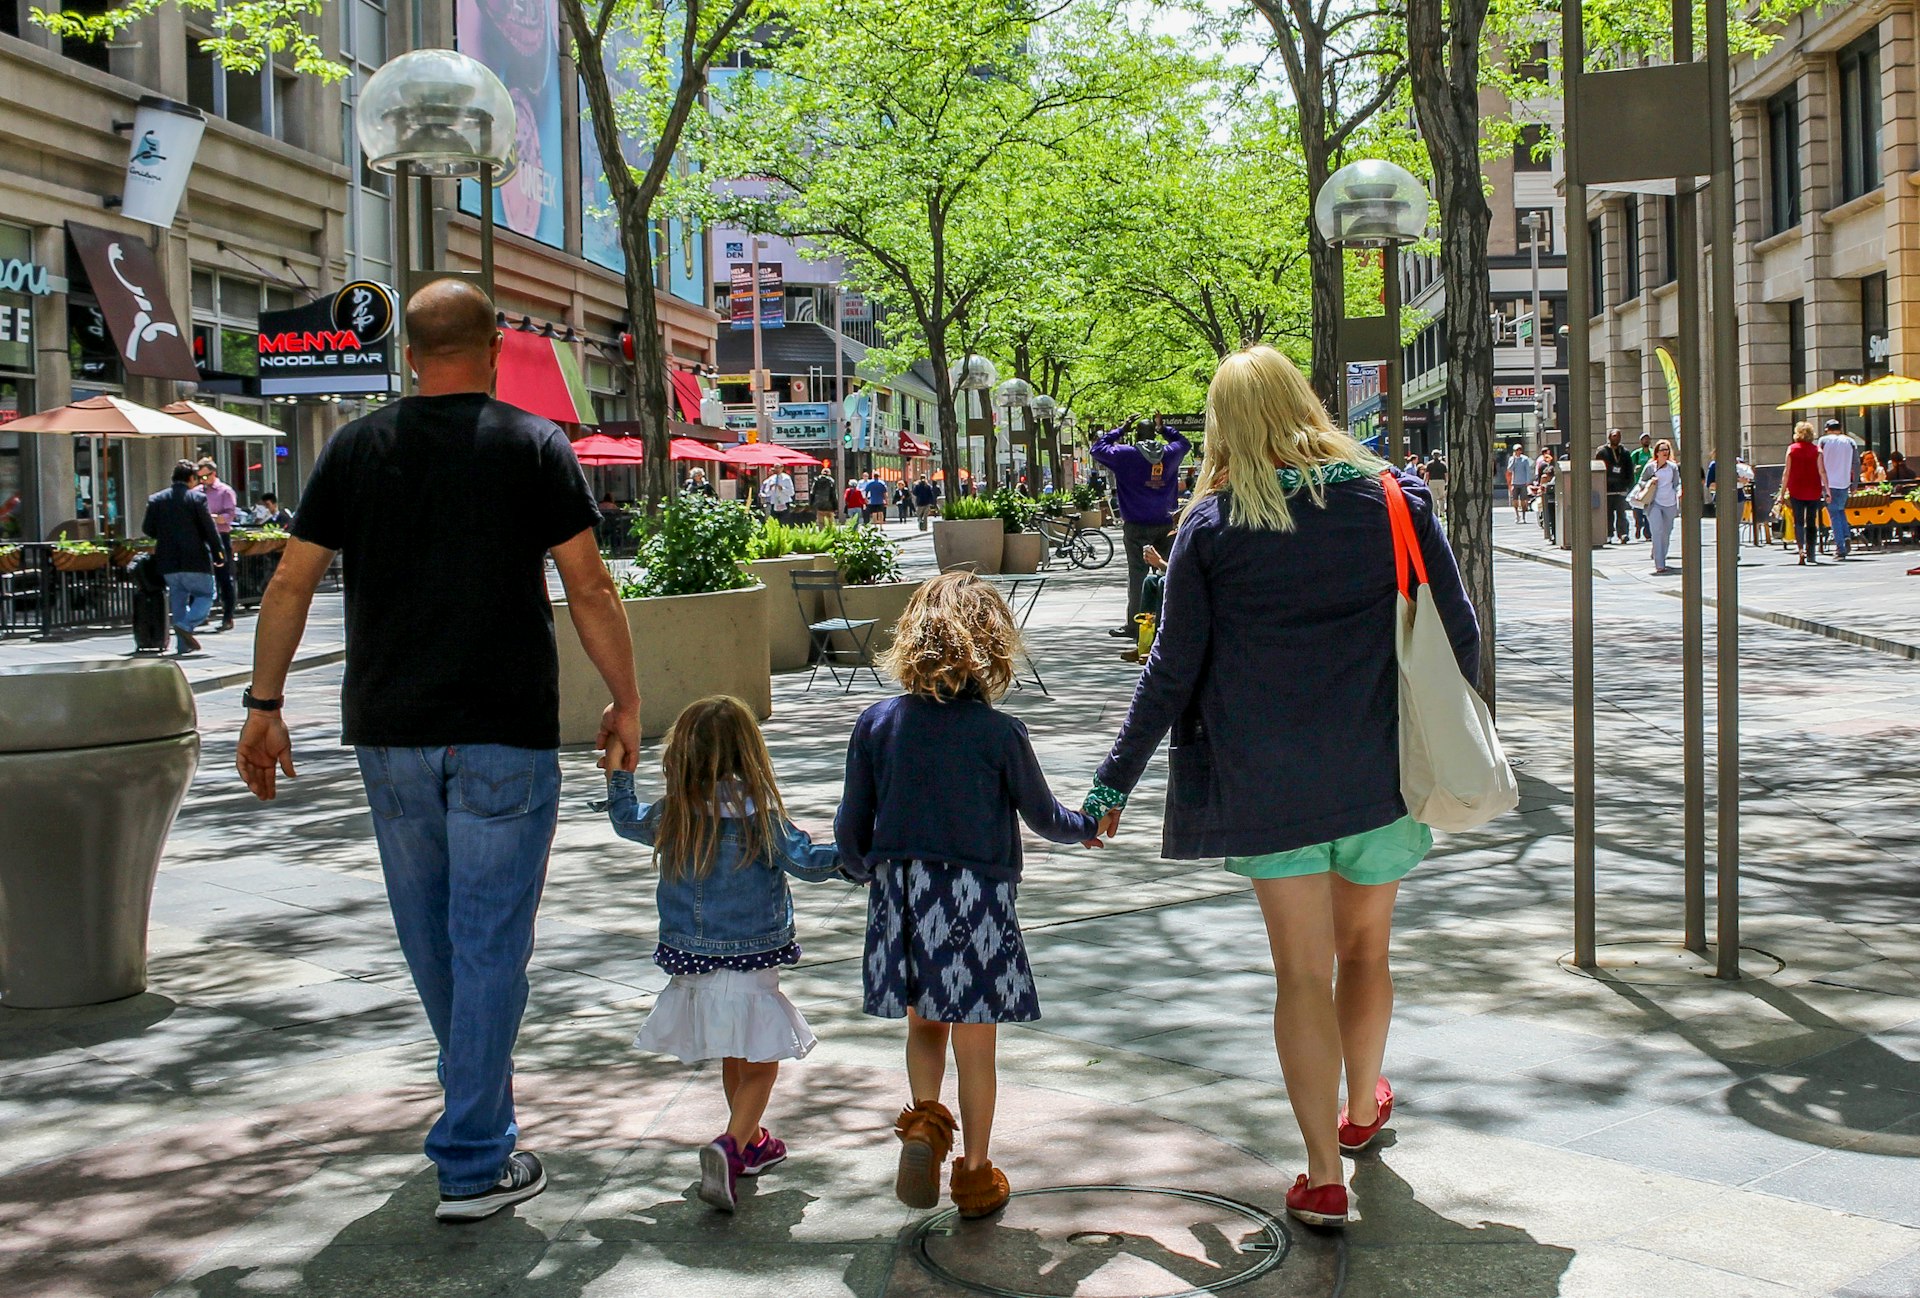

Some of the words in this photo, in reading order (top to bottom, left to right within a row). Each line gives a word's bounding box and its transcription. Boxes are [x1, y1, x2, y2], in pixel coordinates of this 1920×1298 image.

[726, 251, 744, 259] DEN
[258, 330, 361, 353] MENYA
[260, 355, 338, 367] NOODLE
[343, 352, 383, 365] BAR
